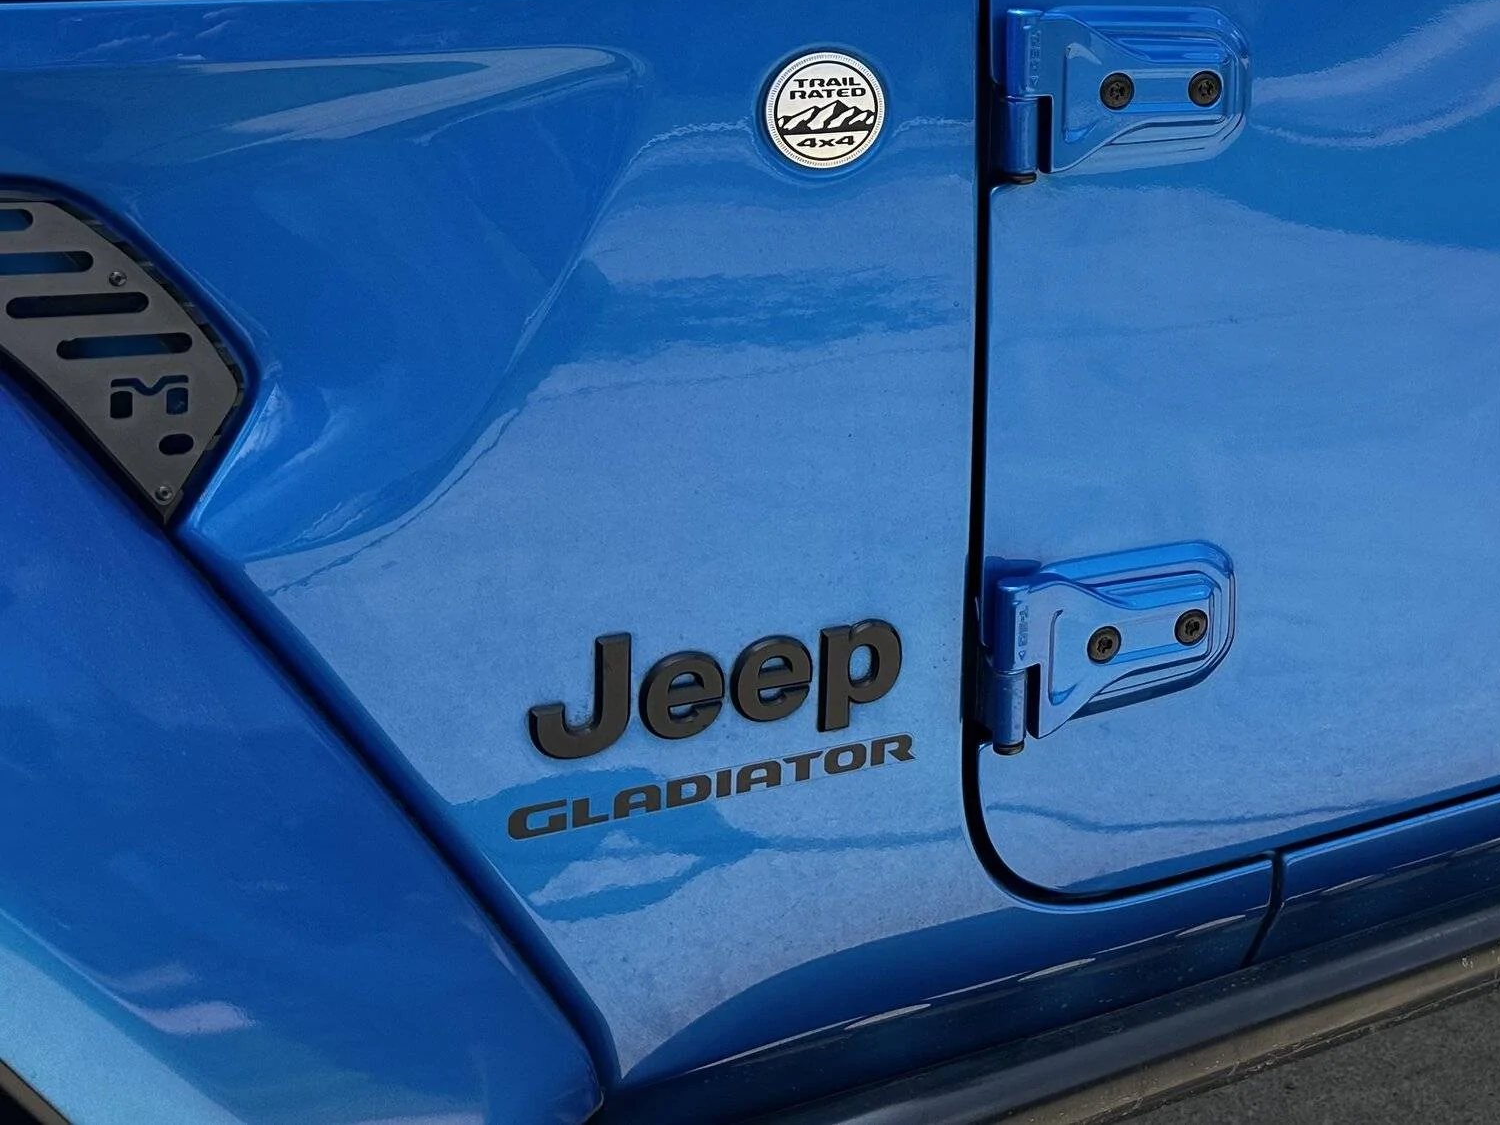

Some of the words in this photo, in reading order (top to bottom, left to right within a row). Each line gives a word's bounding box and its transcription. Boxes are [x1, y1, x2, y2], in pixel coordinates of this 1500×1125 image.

[793, 77, 861, 88] TRAIL
[790, 87, 866, 100] RATED
[797, 135, 855, 148] 4x4
[528, 618, 902, 760] Jeep
[507, 732, 917, 840] GLADIATOR
